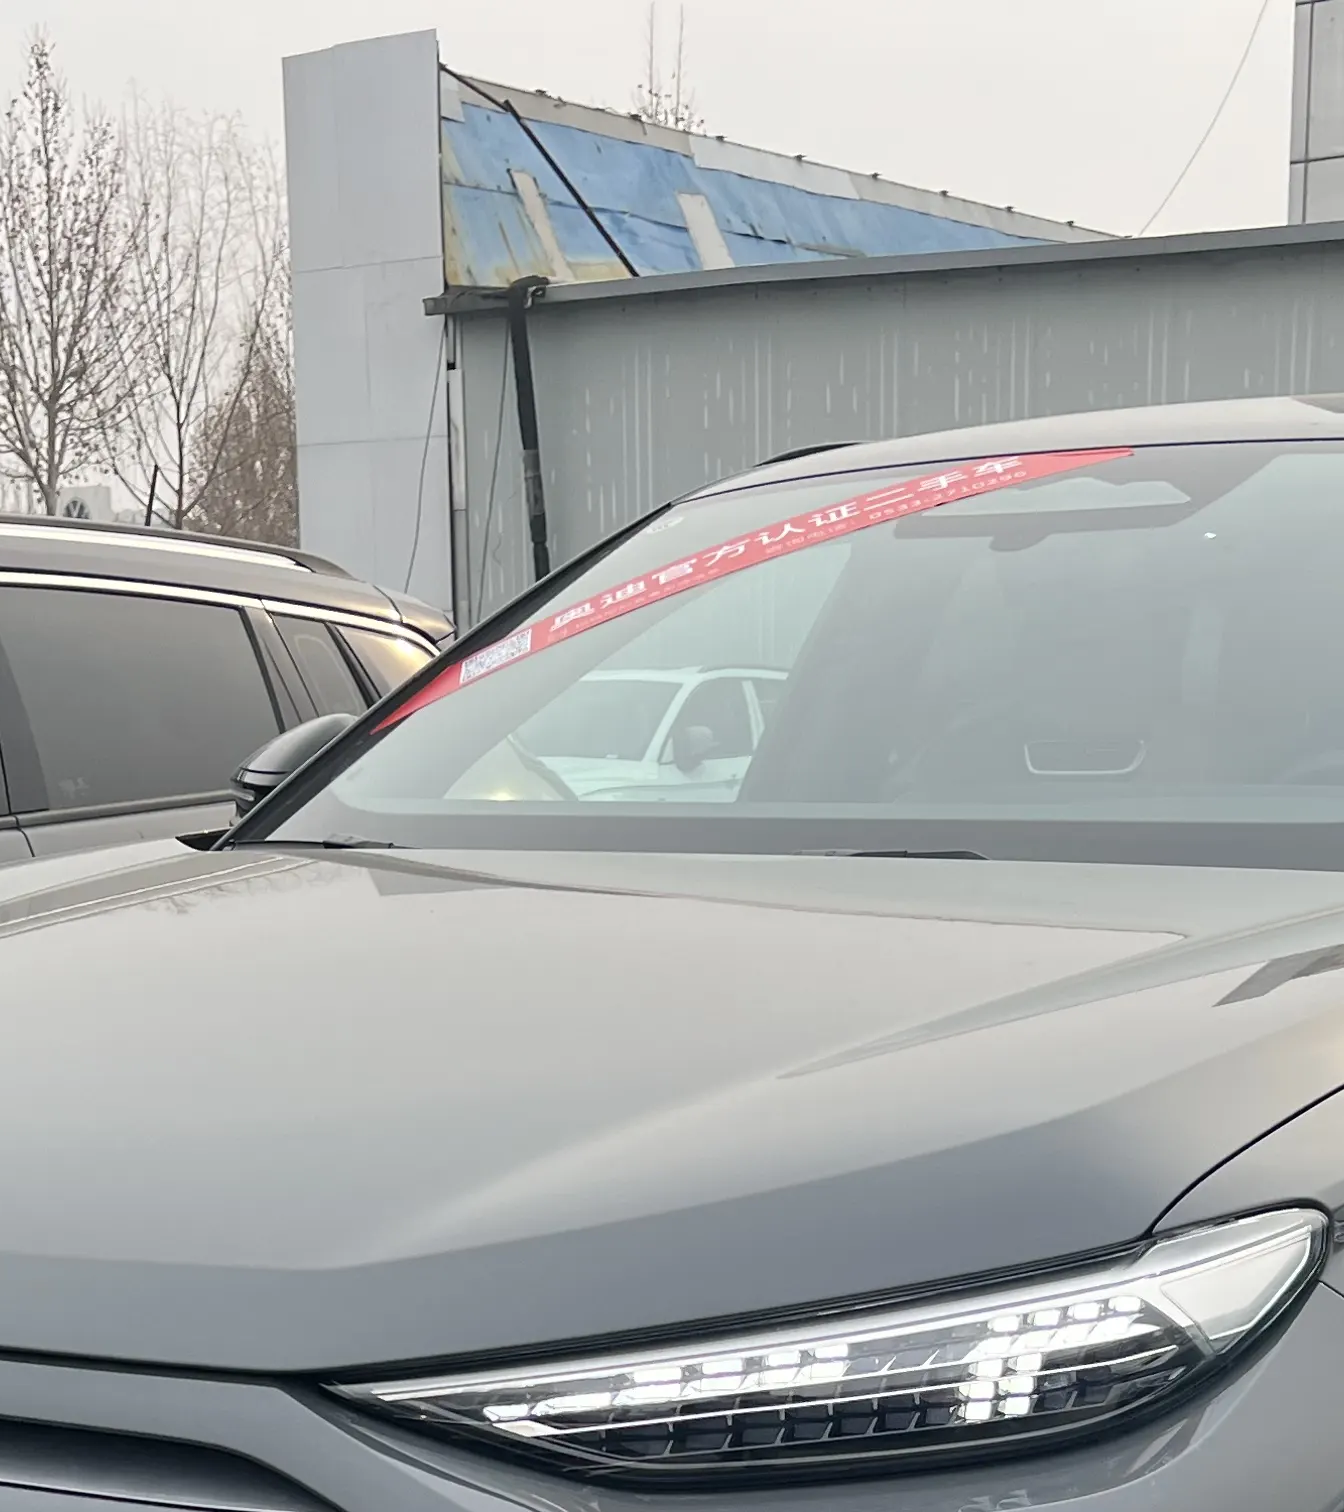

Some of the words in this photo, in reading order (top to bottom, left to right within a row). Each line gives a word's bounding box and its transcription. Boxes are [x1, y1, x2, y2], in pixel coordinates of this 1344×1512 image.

[550, 456, 1023, 632] 奥迪官方认证二手车
